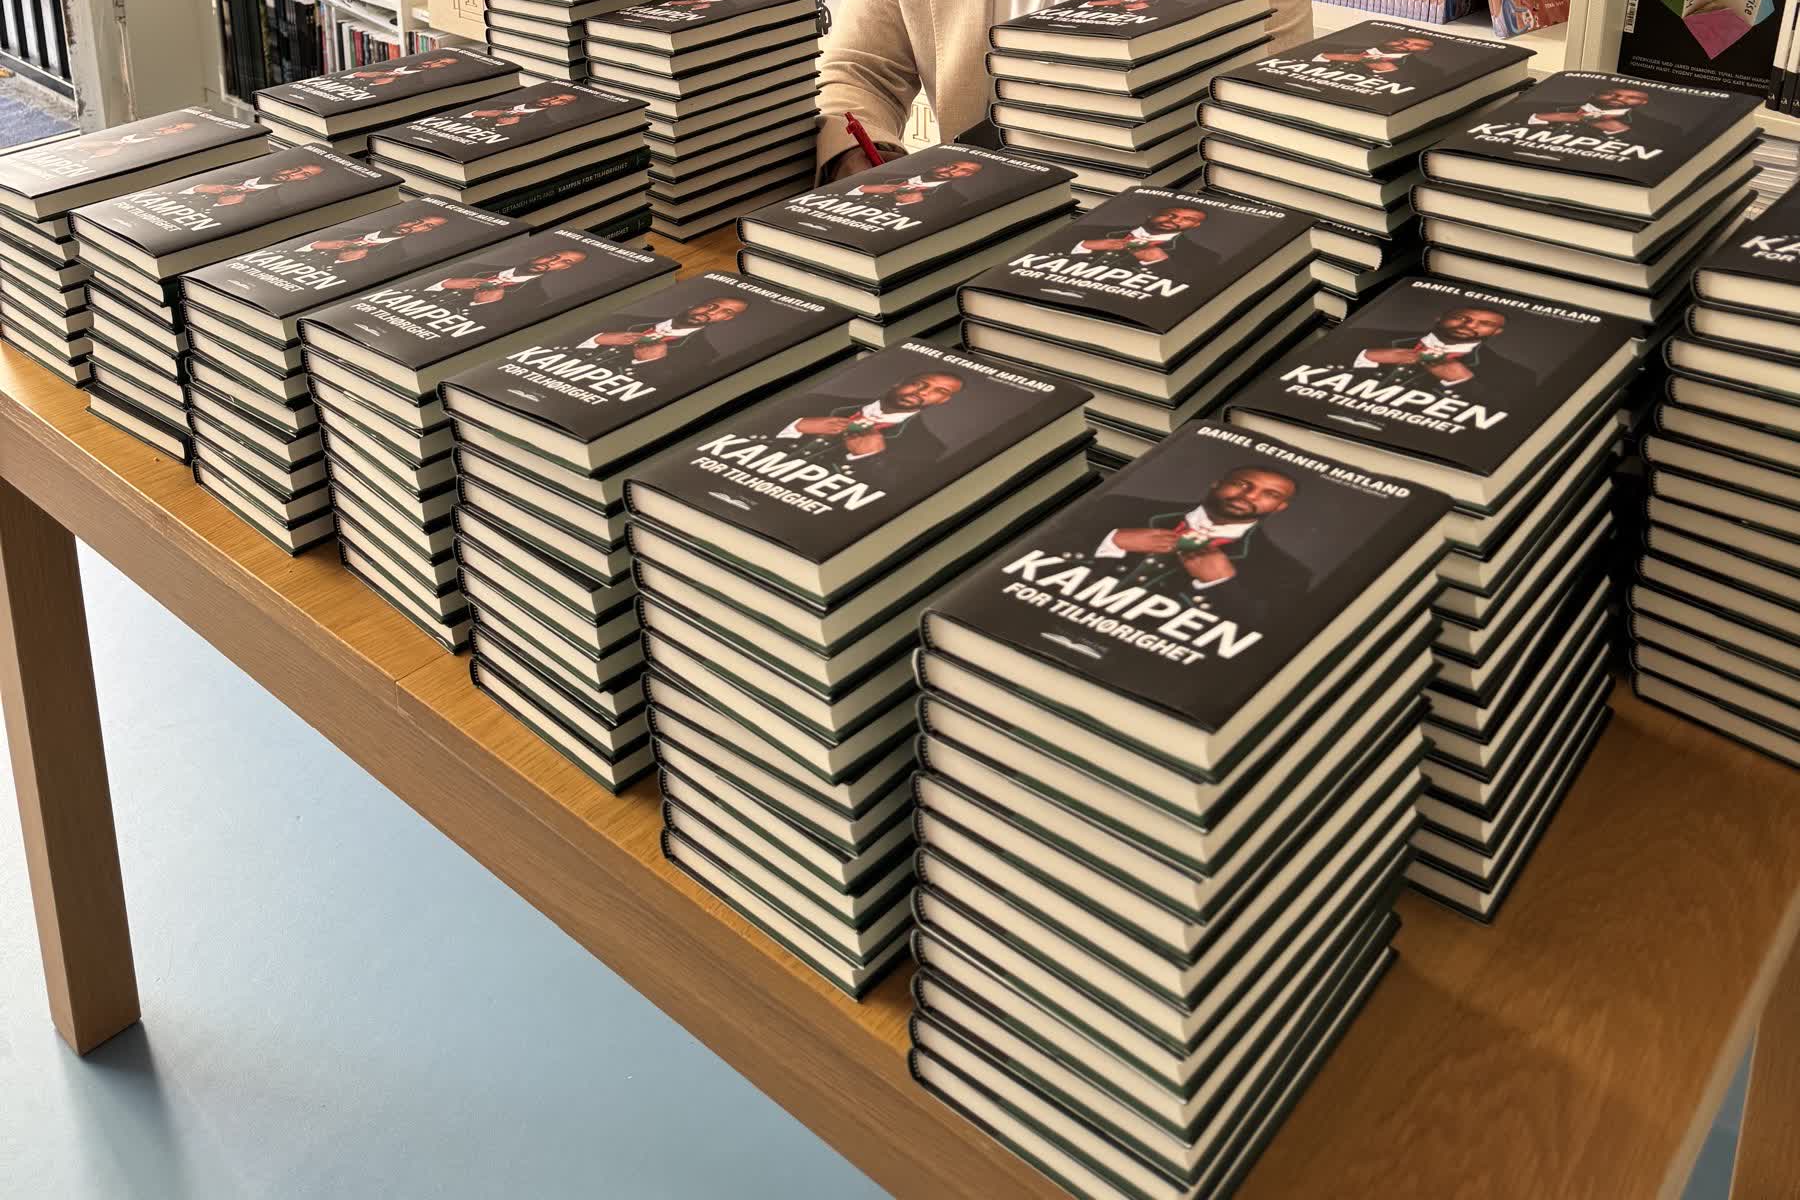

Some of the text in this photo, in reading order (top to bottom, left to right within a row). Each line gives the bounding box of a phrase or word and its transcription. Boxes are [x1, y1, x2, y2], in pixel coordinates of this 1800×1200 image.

[1031, 8, 1159, 24] KAMPEN
[1256, 58, 1416, 95] KAMPEN
[1564, 72, 1730, 99] DANIEL GETANEH HATLAND
[413, 116, 510, 145] KAMPEN
[1467, 123, 1664, 161] KAMPEN
[1473, 134, 1632, 162] FOR TILHØRIGHET
[128, 191, 222, 232] KAMPEN
[785, 205, 886, 234] FOR TILHØRIGHET
[788, 193, 923, 232] KAMPEN
[1134, 188, 1286, 219] DANIEL GETANEH HATLAND
[554, 229, 584, 243] DANIEL
[582, 237, 616, 253] GETANEH
[614, 245, 655, 263] HATLAND
[1752, 250, 1797, 262] FOR
[242, 250, 347, 291] KAMPEN
[1008, 253, 1190, 299] KAMPEN
[1010, 268, 1153, 301] FOR TILHØRIGHET
[704, 272, 738, 288] DANIEL
[737, 282, 780, 301] GETANEH
[778, 293, 826, 313] HATLAND
[1411, 280, 1461, 296] DANIEL
[1464, 290, 1530, 311] GETANEH
[1530, 303, 1601, 324] HATLAND
[350, 302, 442, 342] FOR TILHØRIGHET
[360, 288, 486, 339] KAMPEN
[497, 363, 609, 406] FOR TILHØRIGHET
[506, 346, 657, 403] KAMPEN
[900, 341, 942, 361] DANIEL
[943, 353, 996, 376] GETANEH
[996, 368, 1056, 394] HATLAND
[1280, 364, 1509, 431] KAMPEN
[1285, 384, 1467, 435] FOR TILHØRIGHET
[697, 433, 888, 513] KAMPEN
[1197, 426, 1252, 448] DANIEL
[1255, 442, 1330, 473] GETANEH
[1329, 467, 1411, 498] HATLAND
[690, 456, 833, 515] FOR TILHØRIGHET
[1002, 550, 1264, 659] KAMPEN
[1003, 582, 1052, 607] FOR
[1050, 599, 1206, 665] TILHØRIGHET
